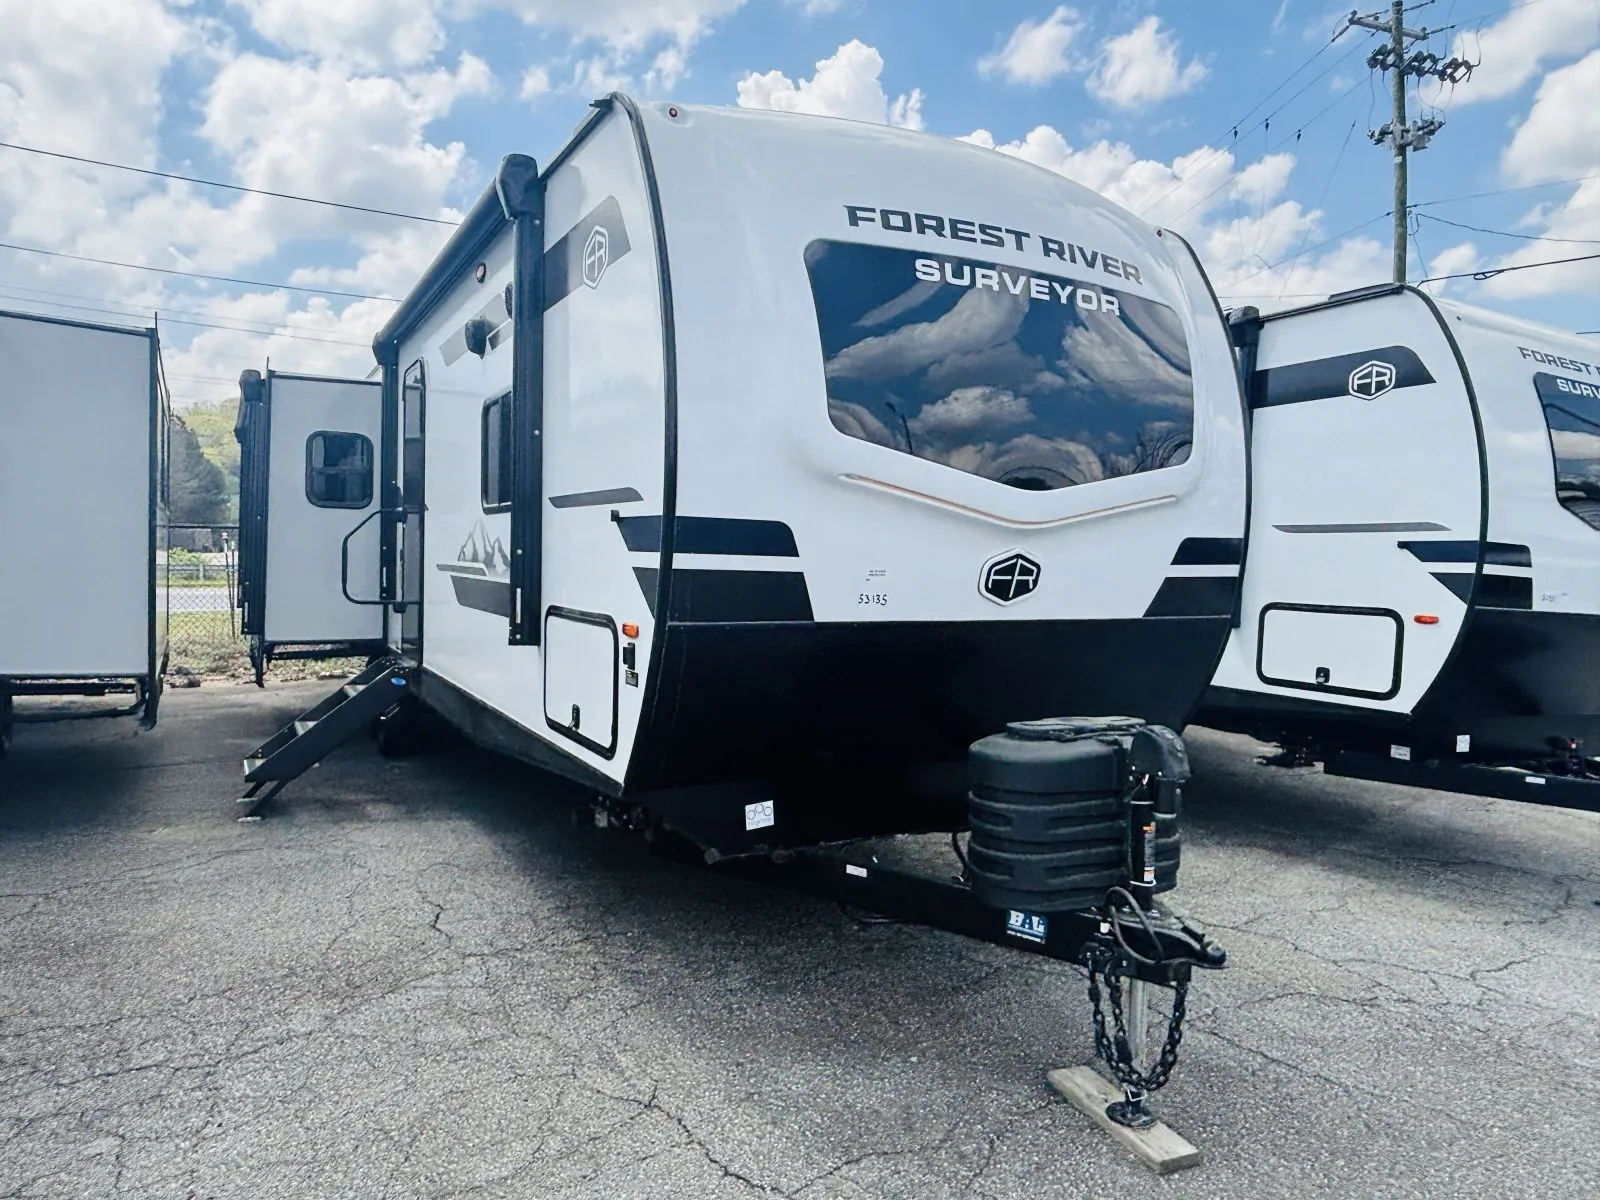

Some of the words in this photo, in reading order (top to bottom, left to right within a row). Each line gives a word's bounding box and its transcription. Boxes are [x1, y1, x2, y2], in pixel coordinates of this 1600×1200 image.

[843, 205, 1031, 252] FOREST
[1038, 235, 1143, 285] RIVER
[915, 258, 1121, 316] SURVEYOR
[1517, 346, 1591, 375] FOREST
[858, 593, 888, 606] 53135
